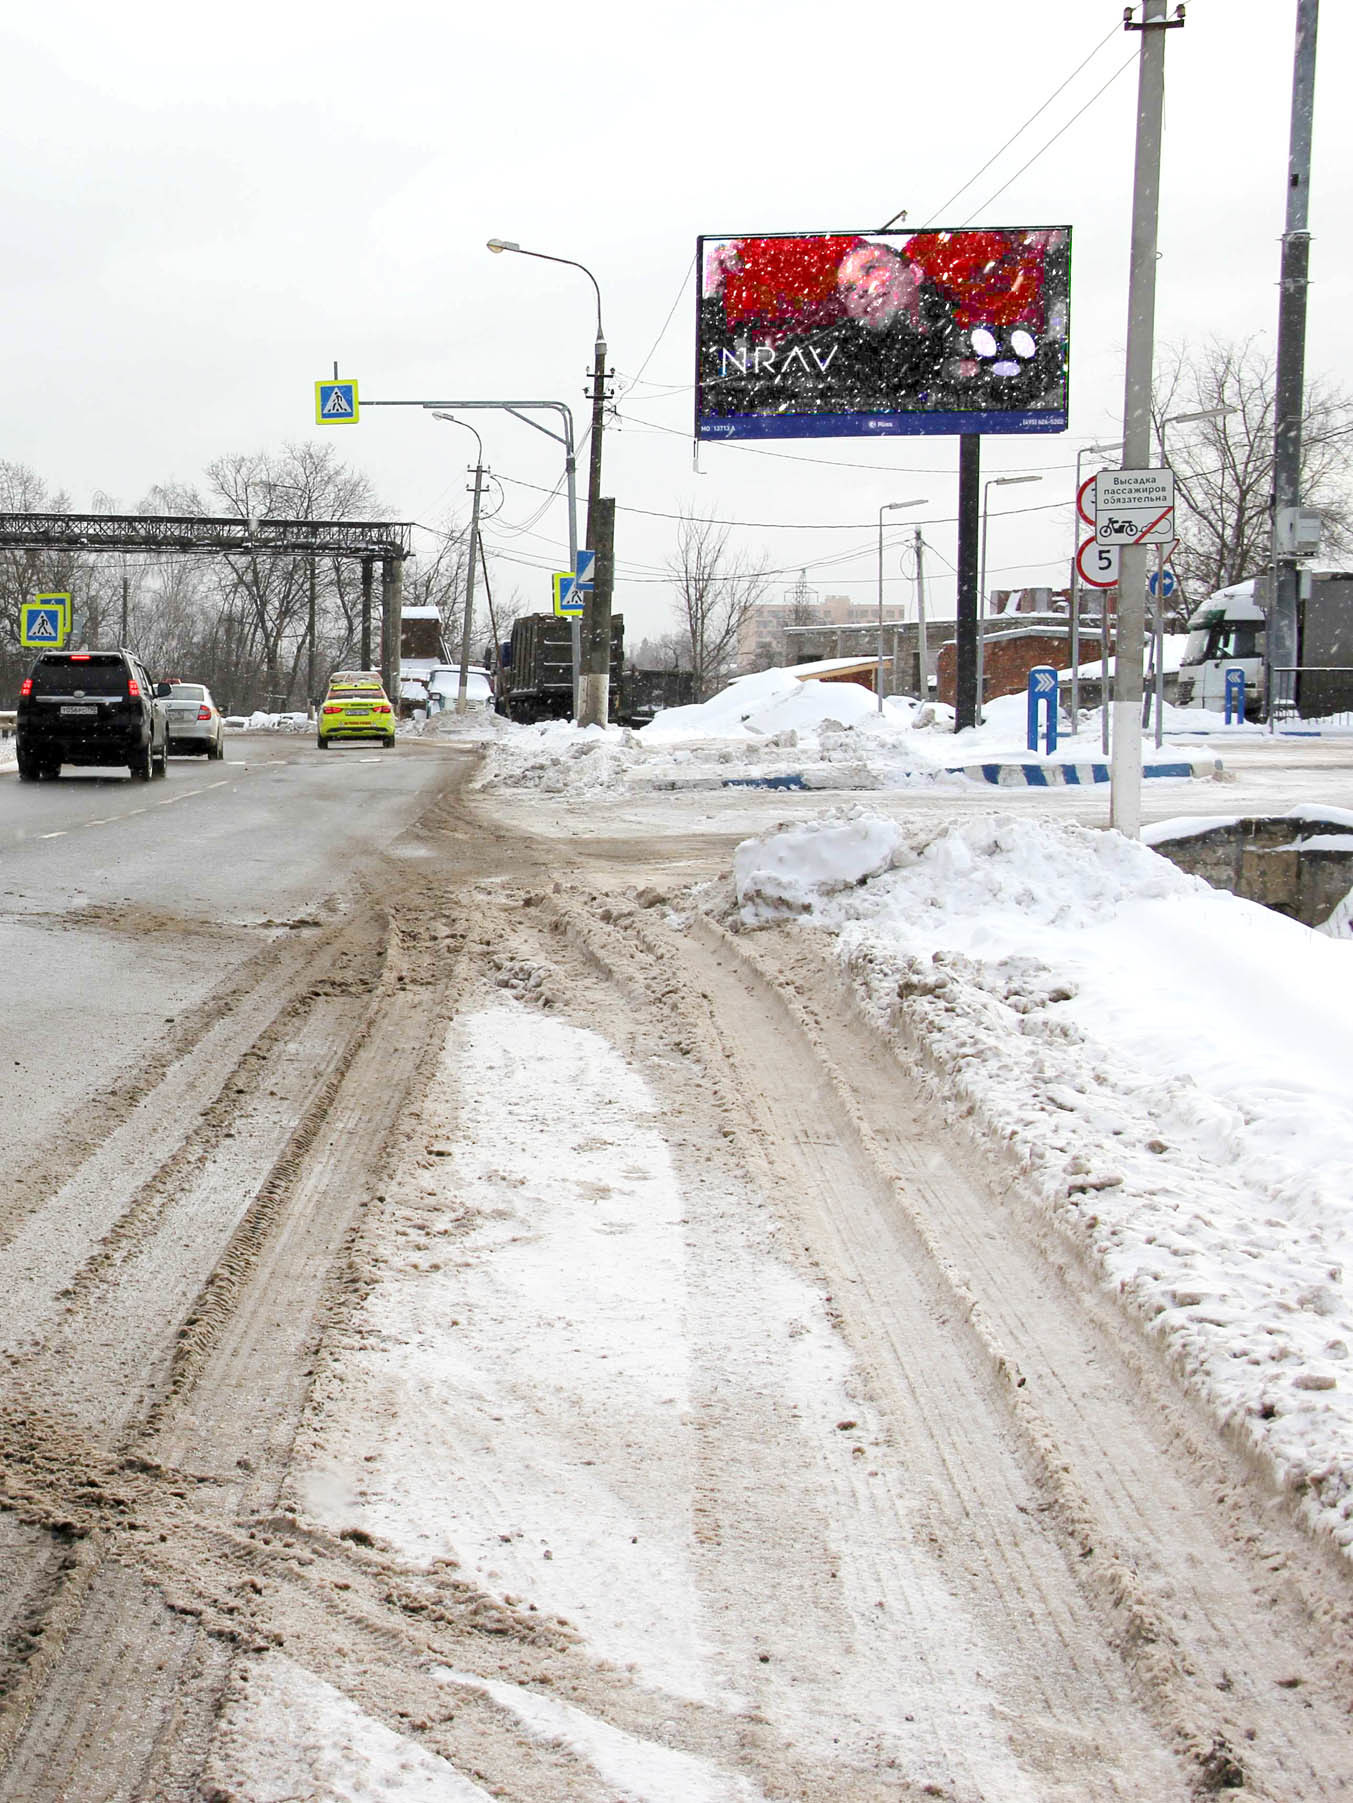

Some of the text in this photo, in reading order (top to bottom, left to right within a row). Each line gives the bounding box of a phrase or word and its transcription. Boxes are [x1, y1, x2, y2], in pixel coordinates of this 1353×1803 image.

[1113, 477, 1156, 485] Высадка
[1104, 486, 1166, 495] пассажиров
[1104, 495, 1167, 504] обязательна
[1098, 550, 1112, 570] 5
